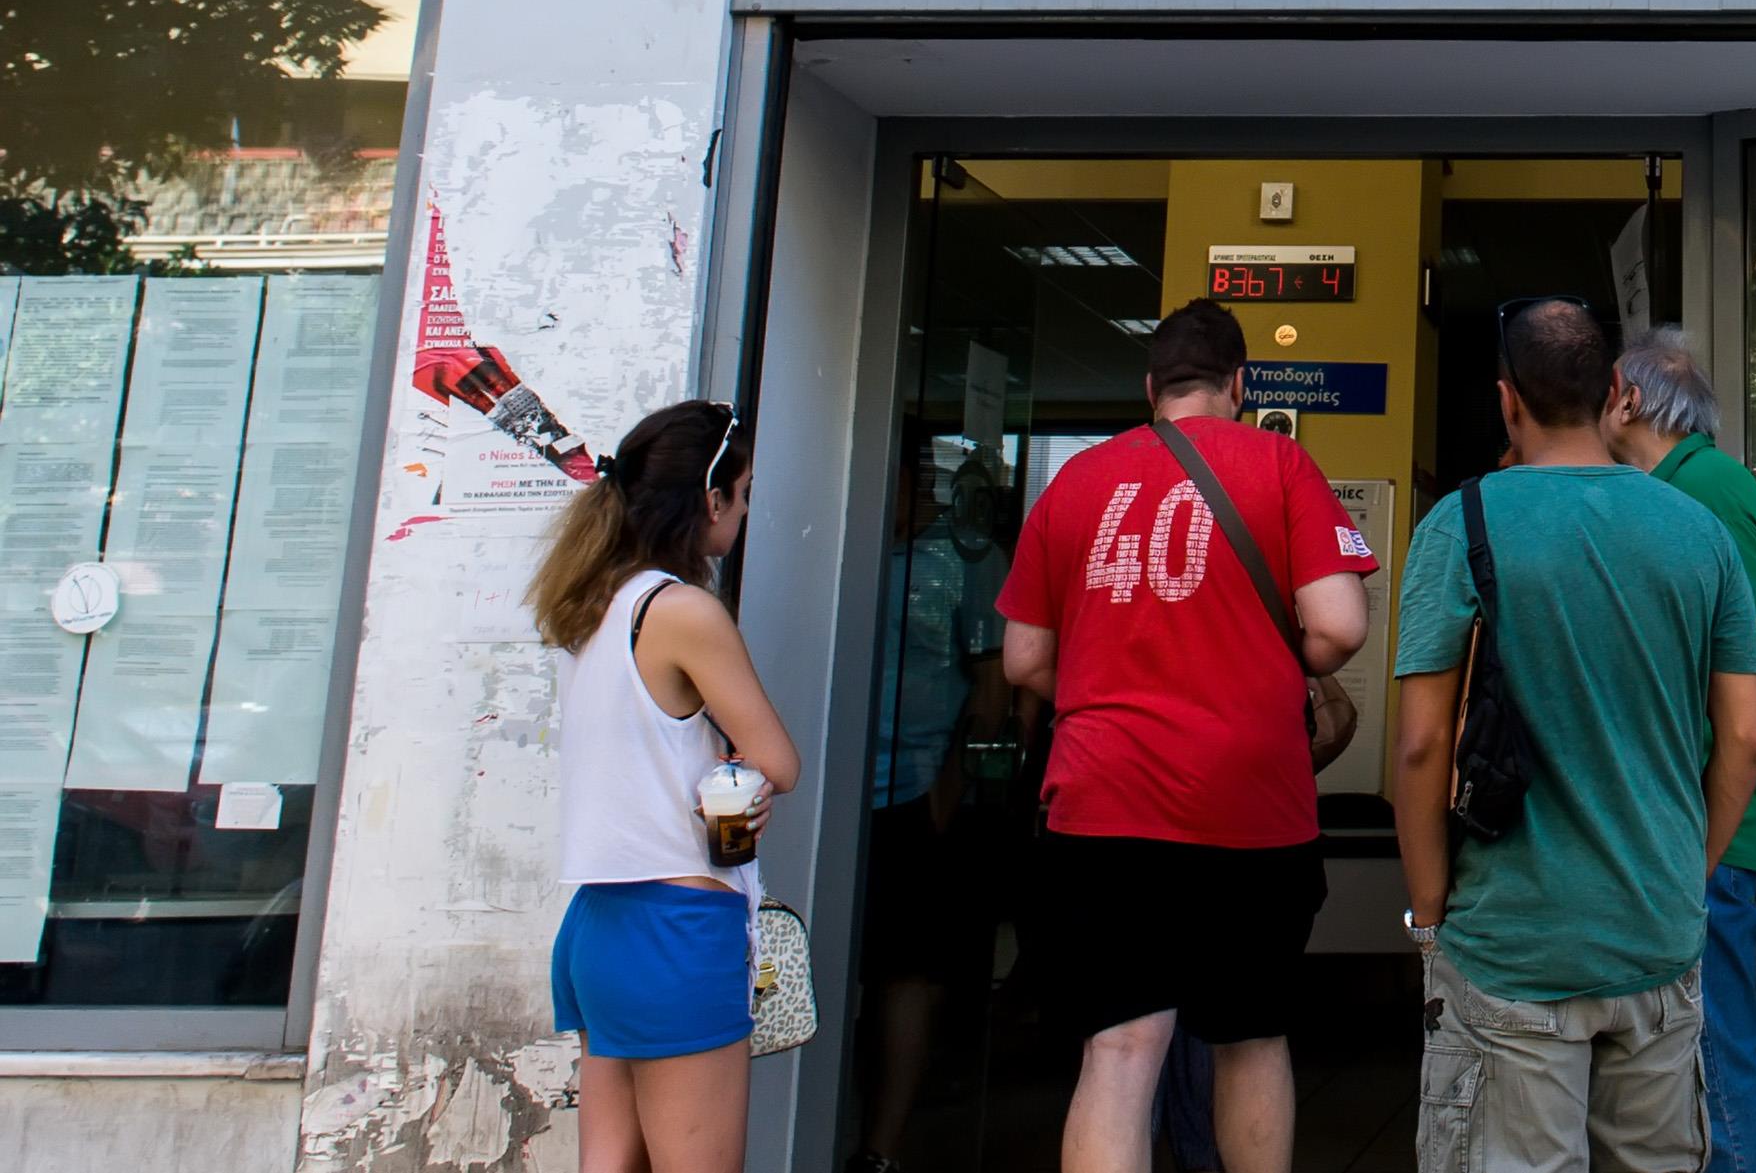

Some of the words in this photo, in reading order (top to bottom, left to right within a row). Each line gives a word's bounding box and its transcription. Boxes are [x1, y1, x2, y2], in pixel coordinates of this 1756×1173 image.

[1321, 267, 1340, 295] 4
[1250, 367, 1325, 385] Υποδοχή
[1244, 388, 1340, 406] ληροφορίες
[519, 480, 533, 488] ΜΕ
[1086, 478, 1215, 604] 40
